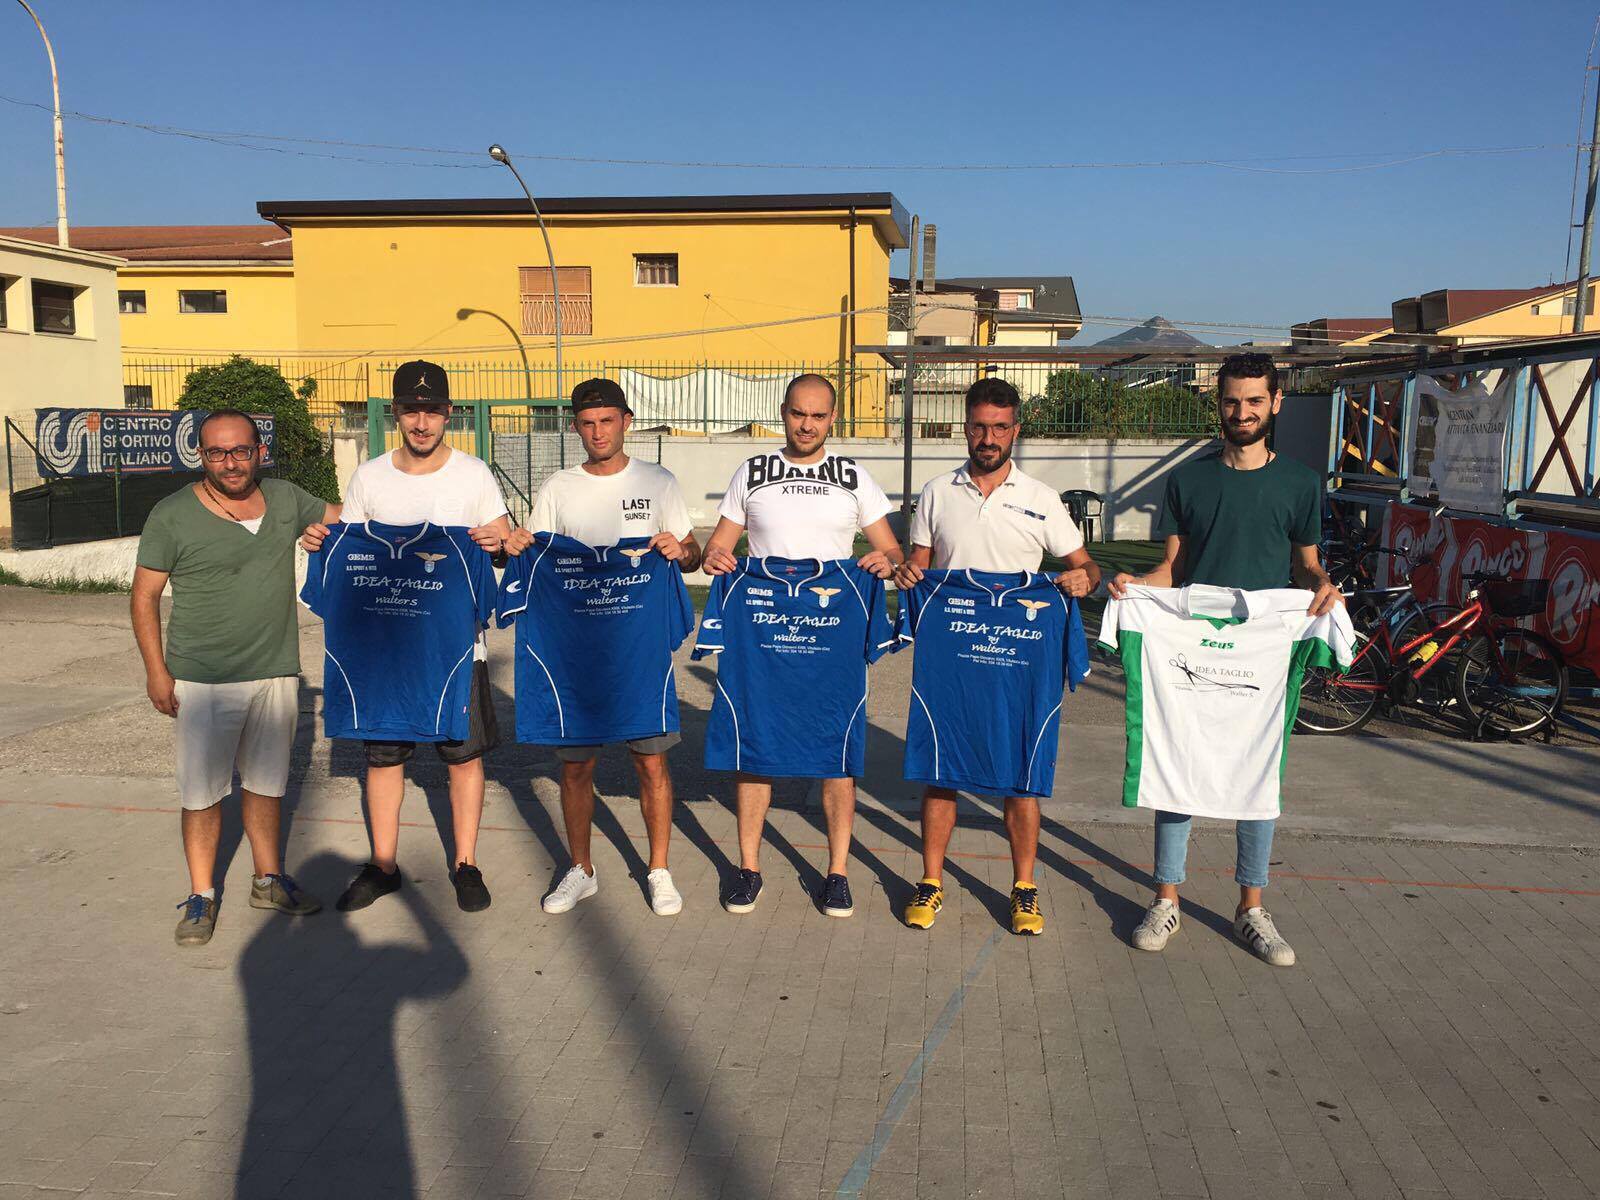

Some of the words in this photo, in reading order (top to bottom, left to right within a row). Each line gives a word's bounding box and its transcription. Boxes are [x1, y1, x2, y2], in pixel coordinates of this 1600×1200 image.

[103, 417, 172, 430] CENTRO
[103, 434, 172, 448] SPORTIVO
[102, 452, 172, 466] ITALIANO
[746, 454, 858, 490] BOXING
[782, 486, 830, 495] XTREME
[622, 498, 650, 510] LAST
[624, 512, 651, 520] SUNSET
[352, 576, 391, 587] IDEA
[394, 578, 443, 590] TAGLIO
[563, 578, 600, 590] IDEA
[604, 573, 651, 586] TAGLIO
[752, 612, 789, 624] IDEA
[793, 616, 840, 627] TAGLIO
[949, 621, 989, 634] IDEA
[993, 626, 1042, 640] TAGLIO
[1195, 666, 1217, 674] IDEA
[1220, 668, 1254, 678] TAGLIO
